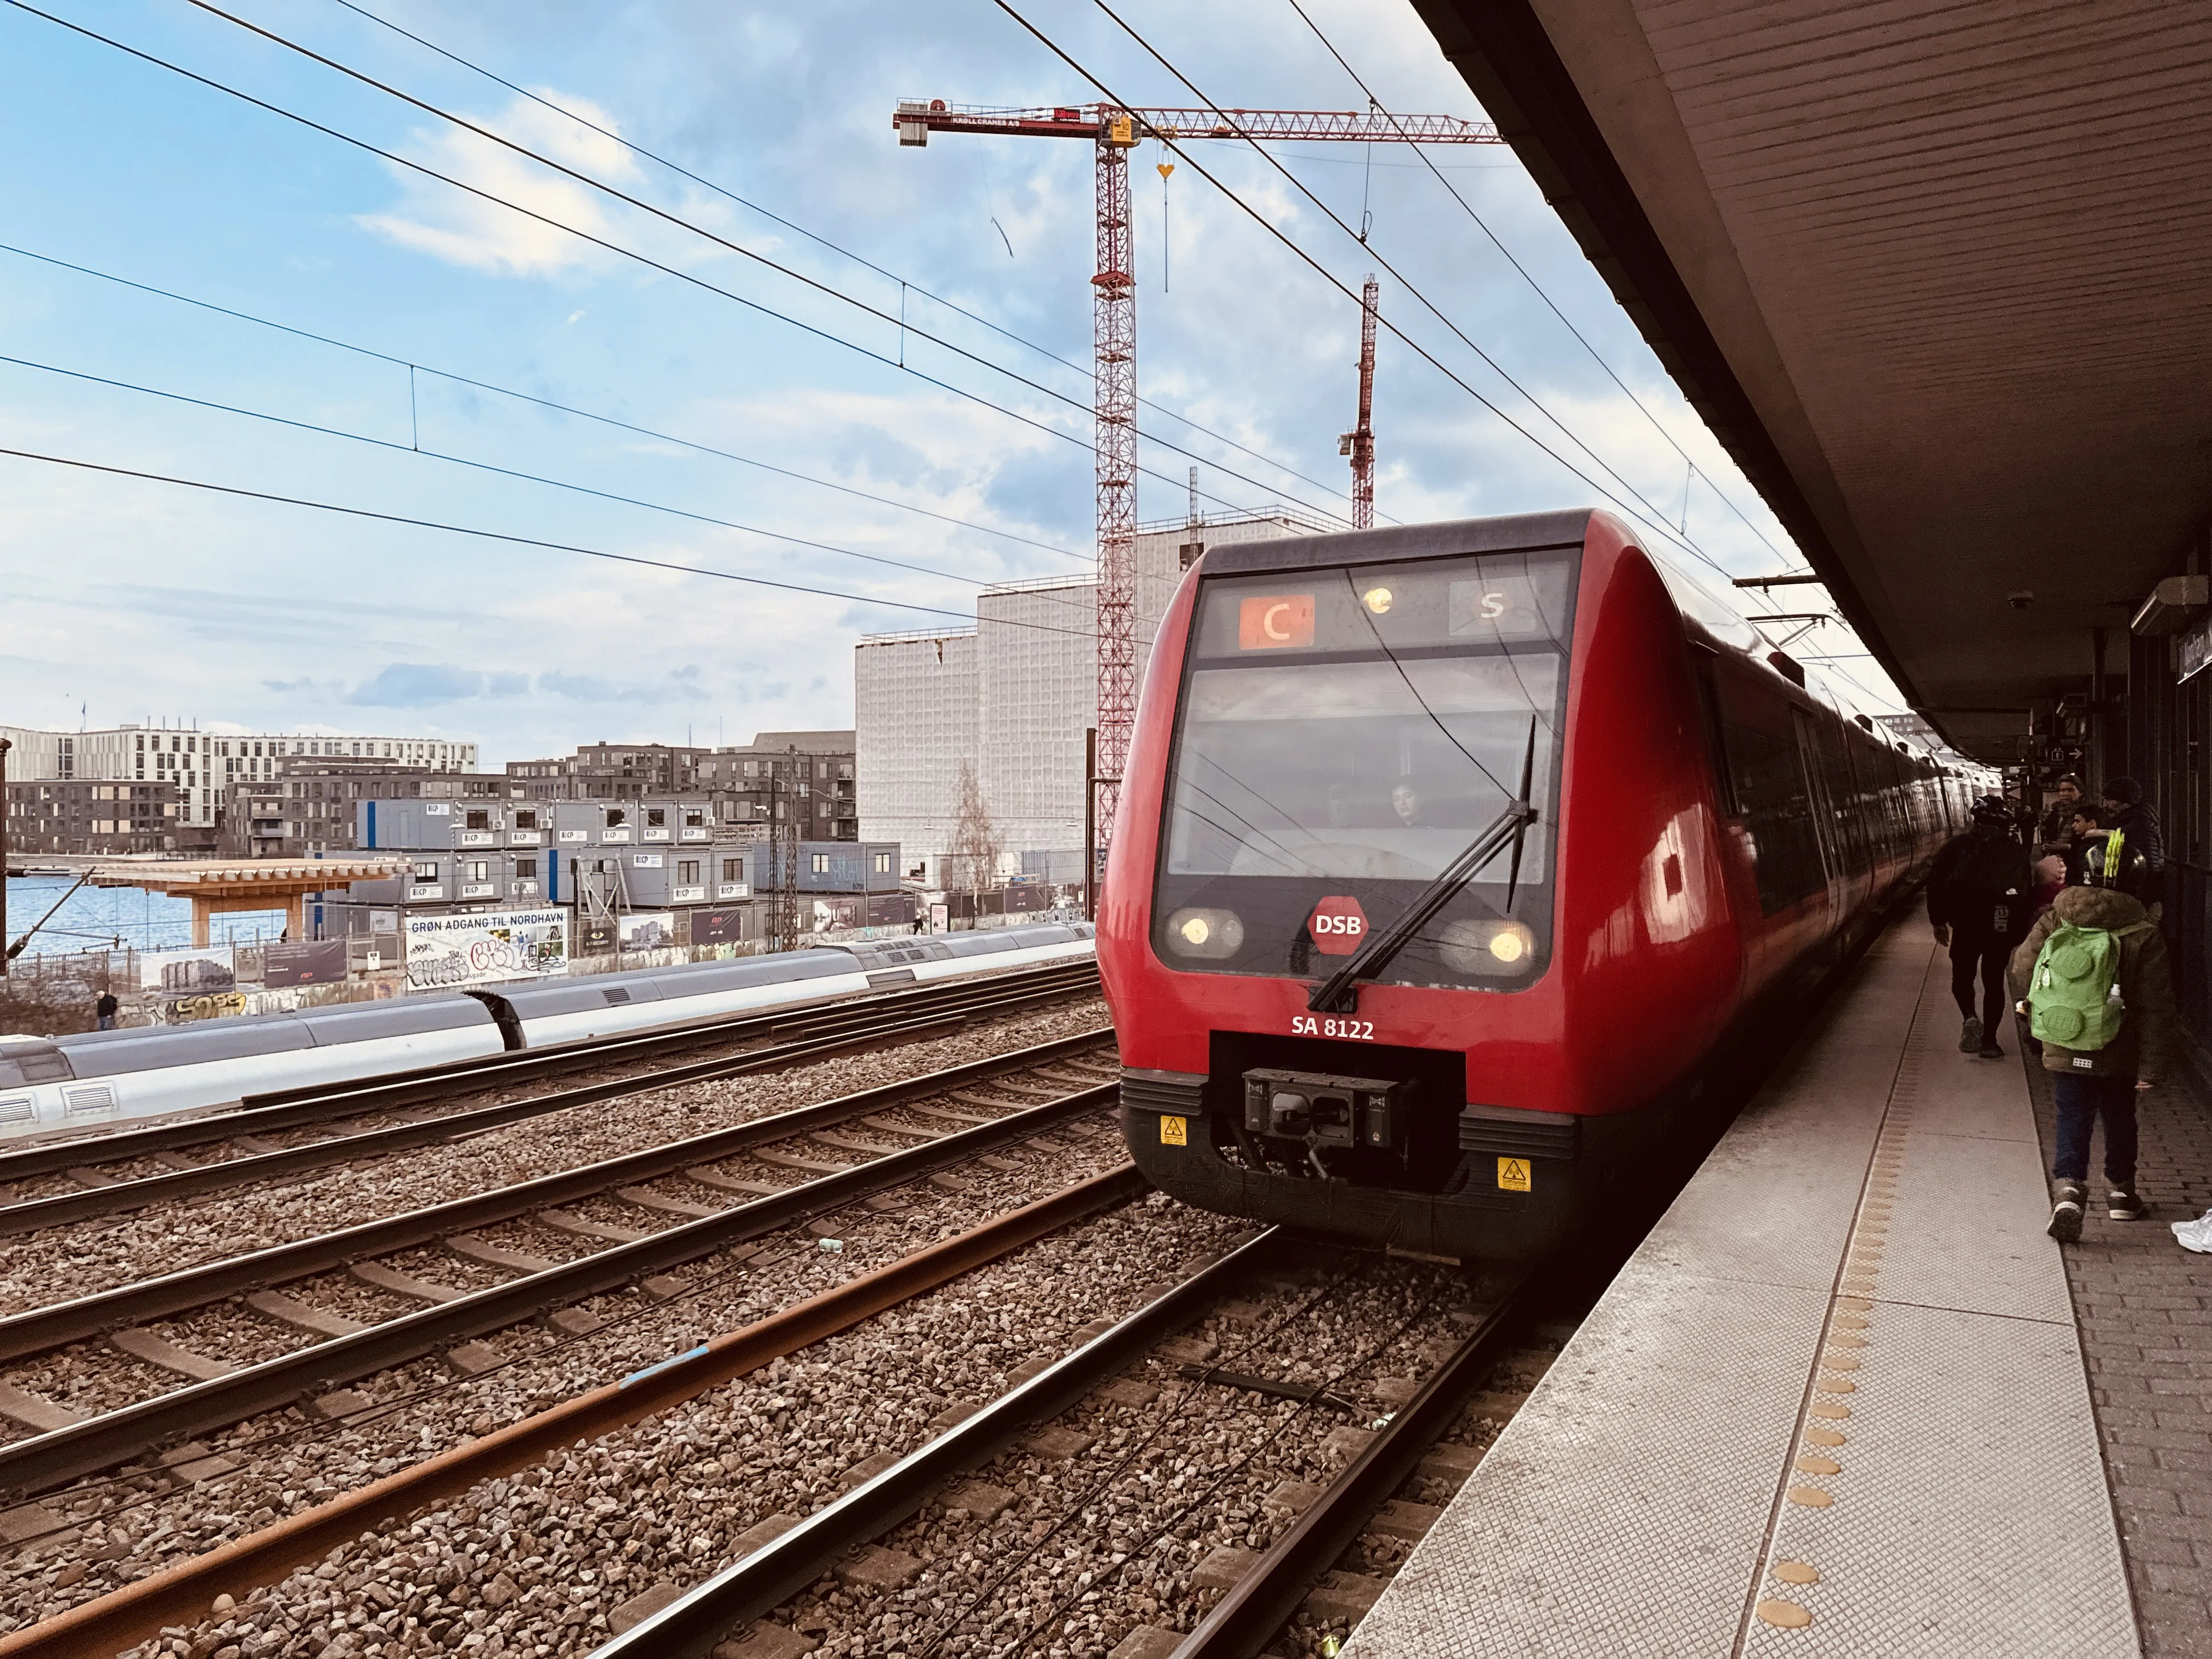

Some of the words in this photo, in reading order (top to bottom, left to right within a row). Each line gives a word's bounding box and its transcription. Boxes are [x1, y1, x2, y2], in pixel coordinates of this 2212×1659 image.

[1481, 592, 1504, 619] S
[1263, 603, 1290, 640] C
[412, 921, 442, 932] GRØN
[445, 918, 488, 930] ADGANG
[492, 916, 507, 927] TIL
[510, 912, 563, 925] NORDHAVN
[1316, 915, 1361, 935] DSB
[1292, 1016, 1318, 1035] SA
[1324, 1019, 1374, 1040] 8122
